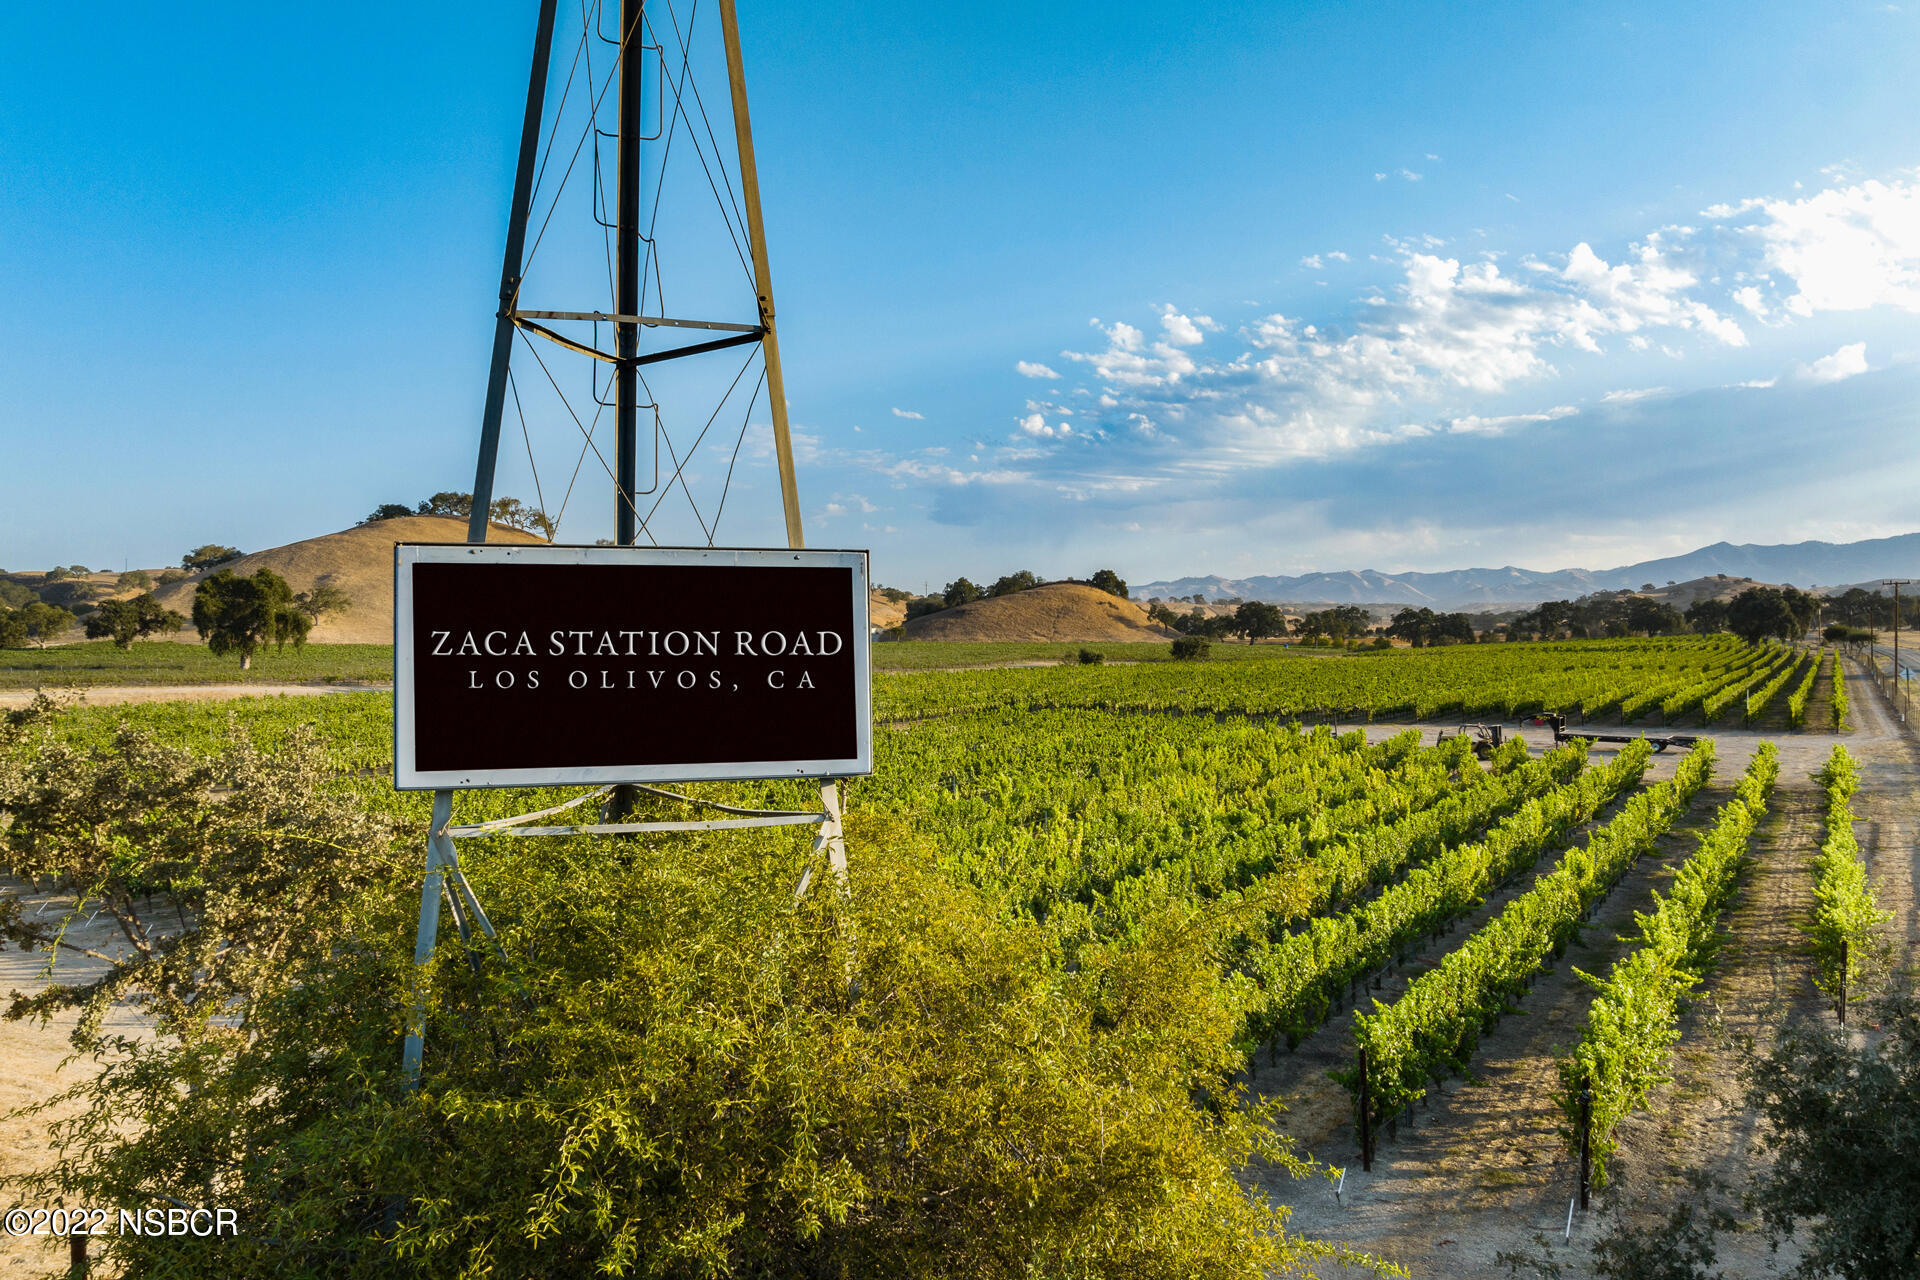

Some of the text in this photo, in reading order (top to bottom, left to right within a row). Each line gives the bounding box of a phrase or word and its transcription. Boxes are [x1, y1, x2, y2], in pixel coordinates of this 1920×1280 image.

[431, 630, 843, 656] ZACA STATION ROAD
[468, 670, 816, 692] LOS OLIVOS, CA
